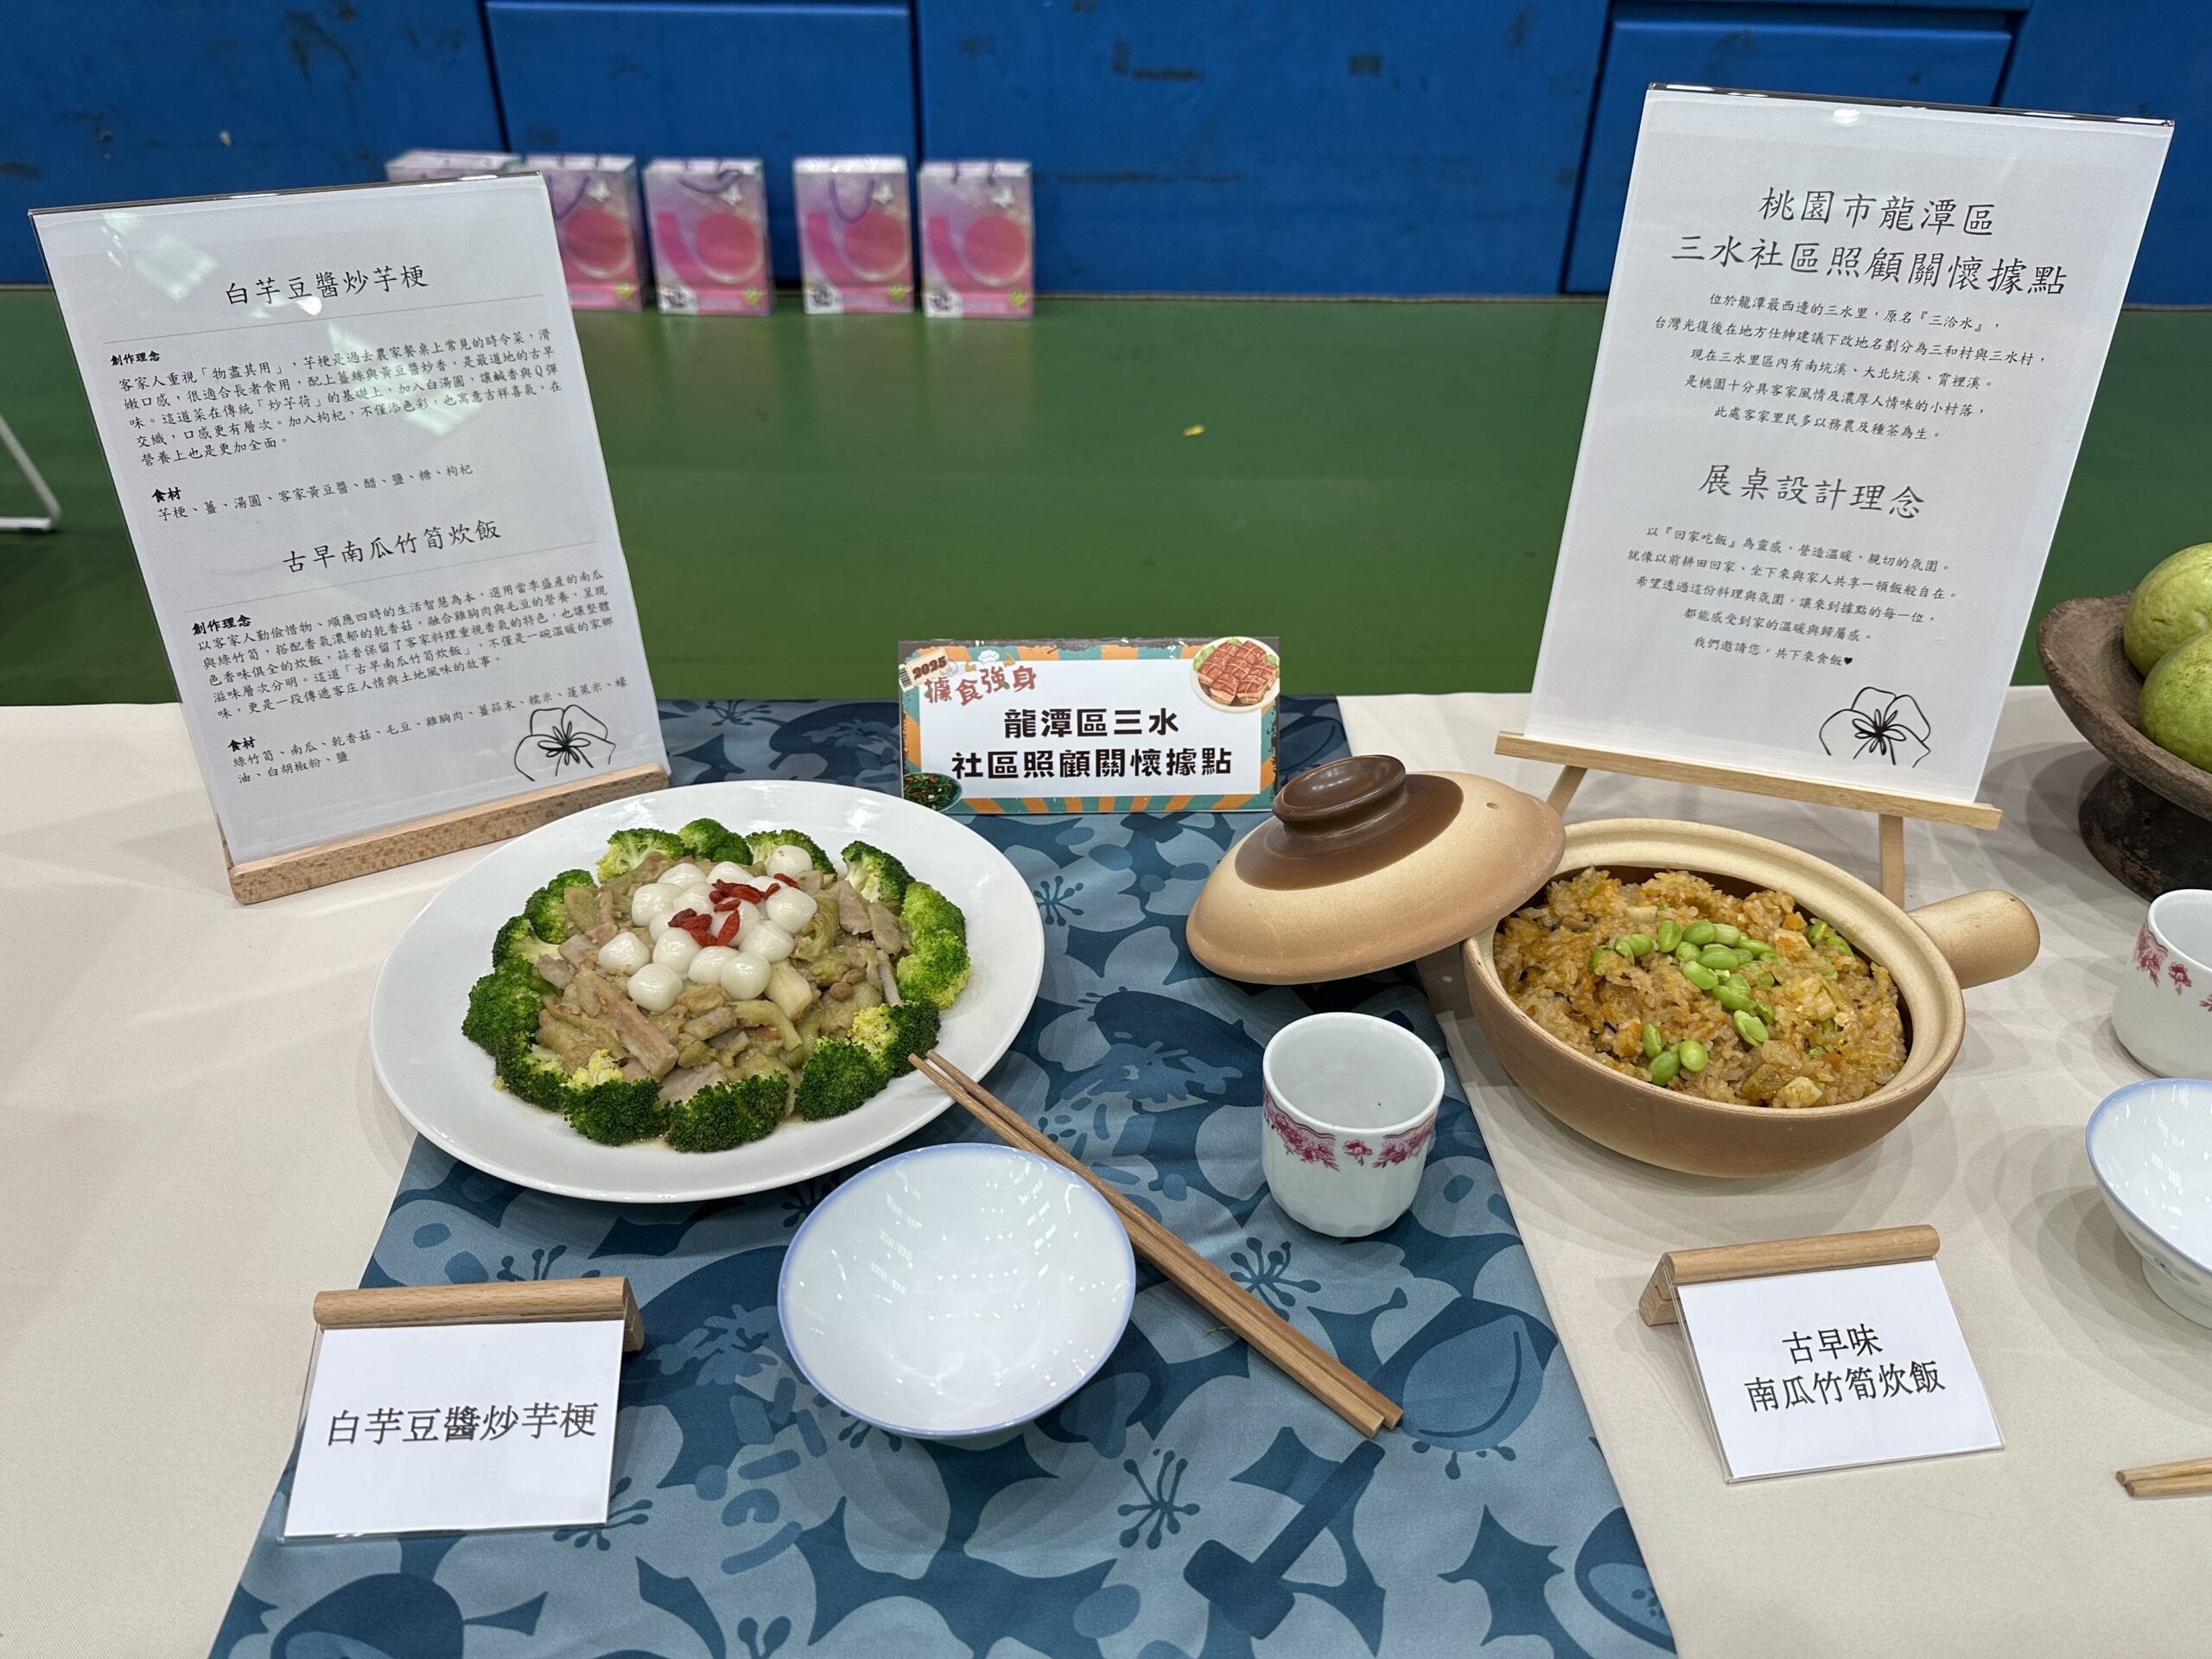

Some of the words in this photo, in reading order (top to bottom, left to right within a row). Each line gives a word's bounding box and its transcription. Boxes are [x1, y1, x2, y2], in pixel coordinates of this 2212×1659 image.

[1758, 187, 1995, 236] 桃園市龍潭區
[226, 264, 429, 305] 白芋豆醬炒芋梗
[1671, 234, 2068, 296] 三水社區照顧關懷據點
[111, 350, 161, 366] 創作理念
[151, 486, 181, 503] 食材
[1697, 464, 1925, 519] 展桌設計理念
[282, 519, 501, 574] 古早南瓜竹筍炊飯
[192, 614, 251, 635] 創作理念
[912, 657, 948, 681] 2025
[1003, 708, 1179, 738] 龍潭區三水
[228, 736, 256, 753] 食材
[950, 747, 1233, 779] 社區照顧關懷據點
[1782, 1323, 1884, 1364] 古早味
[1744, 1359, 1946, 1413] 南瓜竹筍炊飯
[327, 1402, 599, 1446] 白芋豆醬炒芋梗
